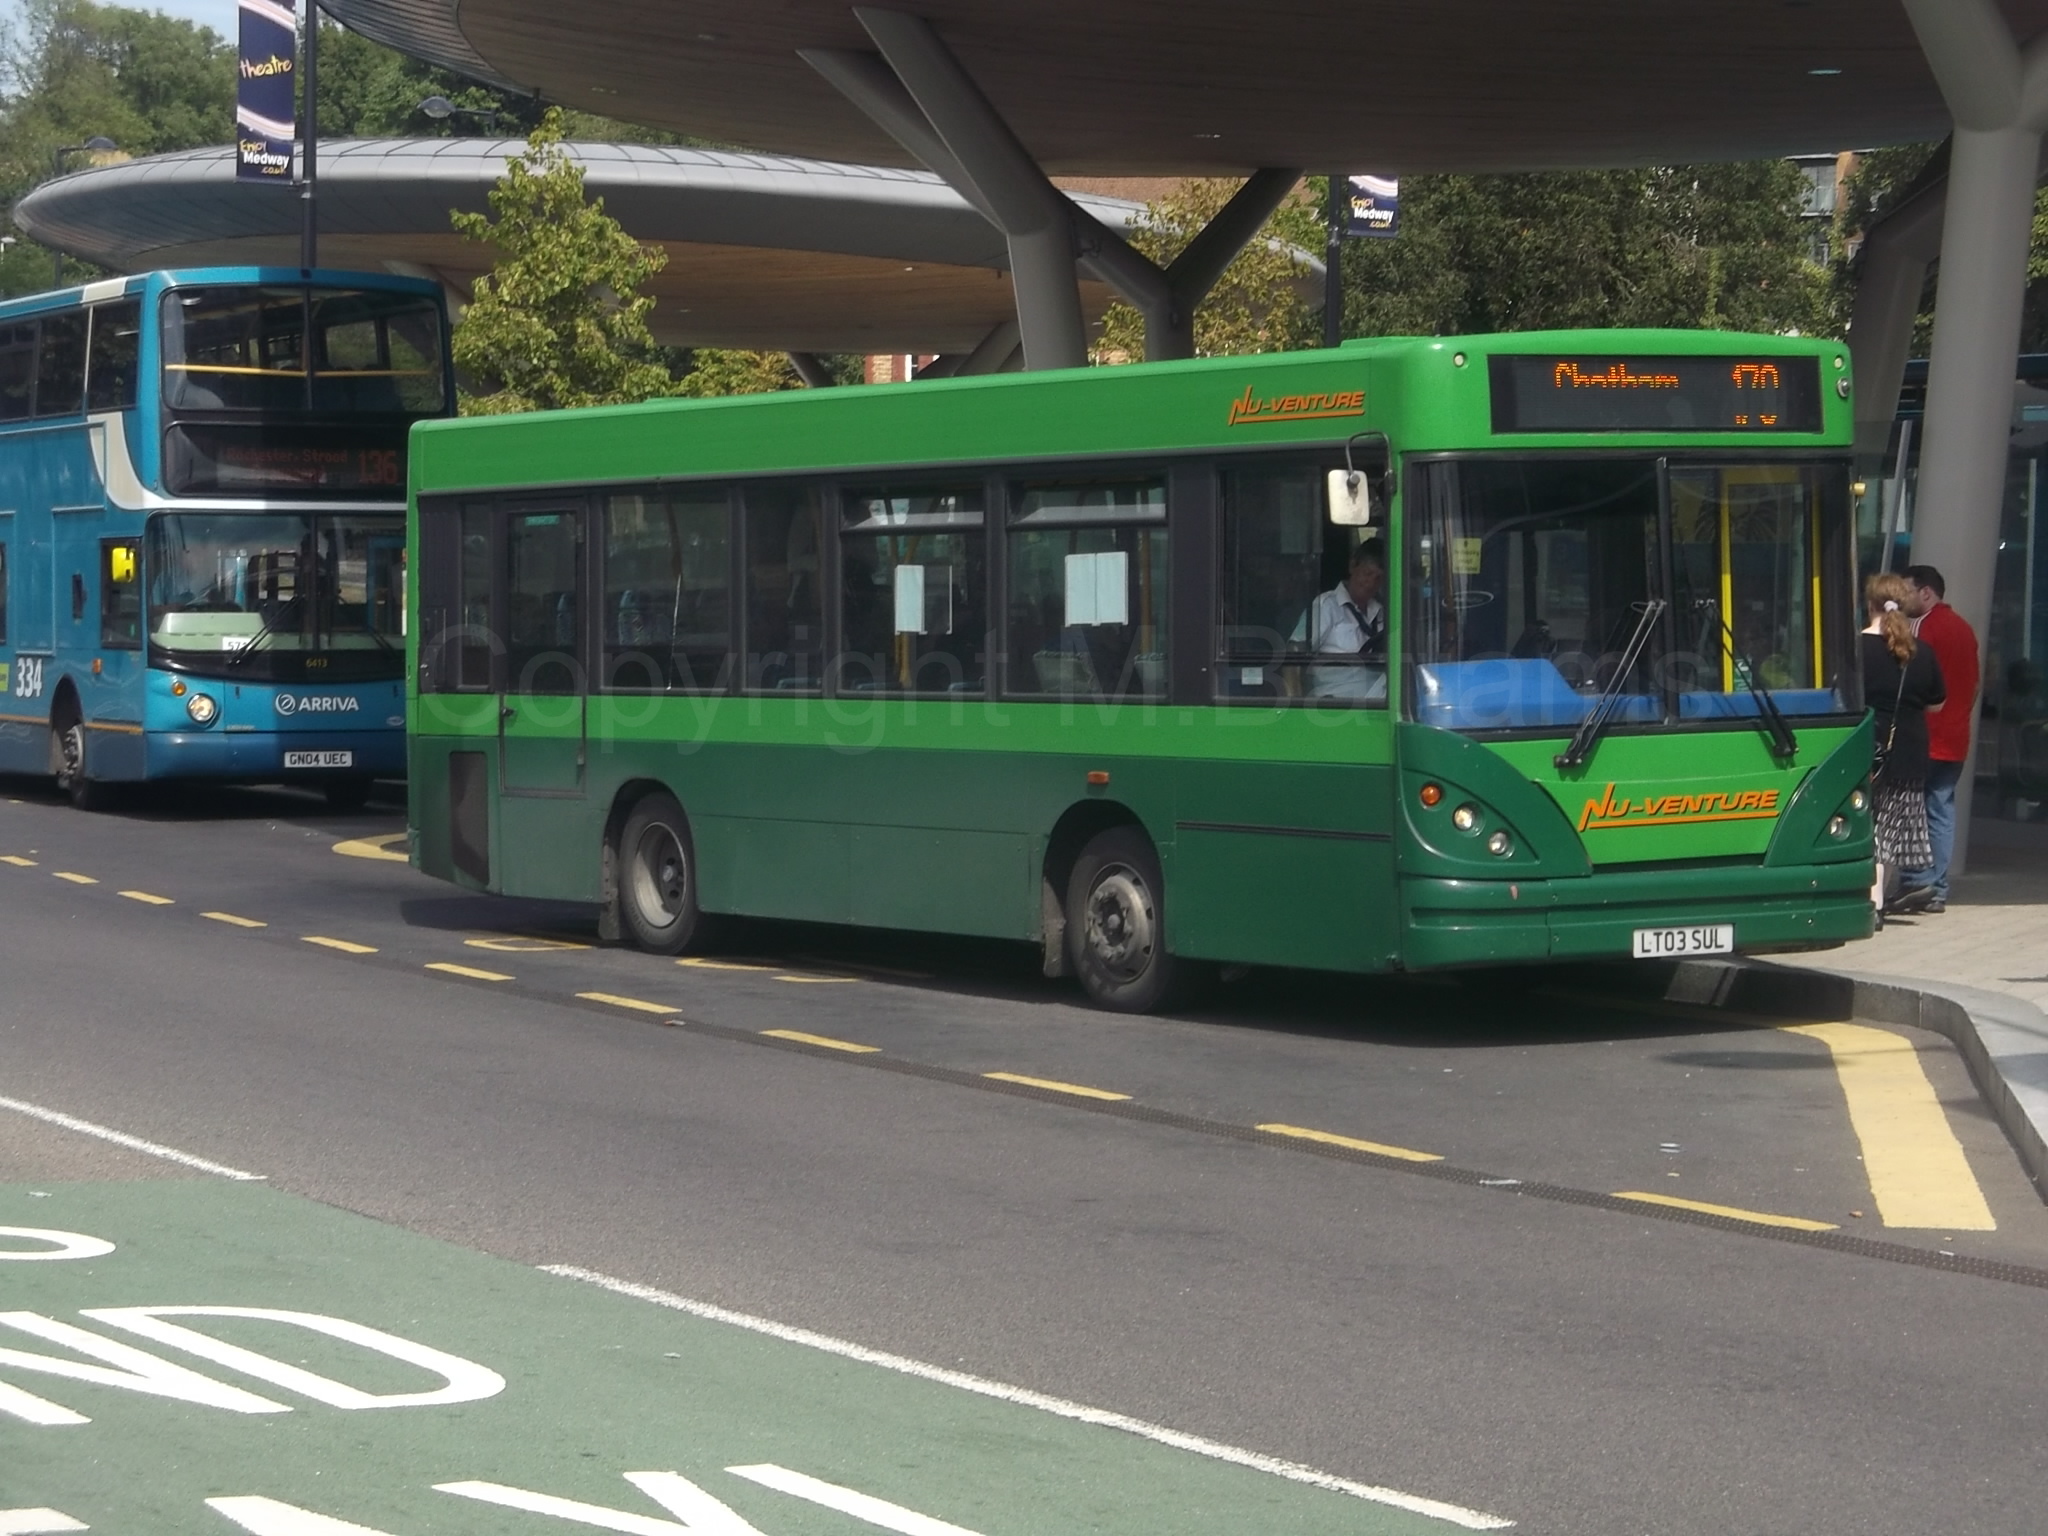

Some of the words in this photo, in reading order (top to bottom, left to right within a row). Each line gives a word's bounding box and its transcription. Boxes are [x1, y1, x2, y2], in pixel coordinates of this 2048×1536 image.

[240, 54, 293, 78] theatre
[243, 152, 289, 168] Medway
[1354, 207, 1394, 223] Medway
[358, 450, 399, 484] 136
[305, 658, 328, 668] 6413
[16, 657, 43, 698] 334
[298, 697, 360, 712] ARRIVA
[289, 752, 320, 765] GN04
[324, 752, 347, 765] UEC
[1641, 930, 1686, 954] LT03
[1691, 928, 1725, 950] SUL
